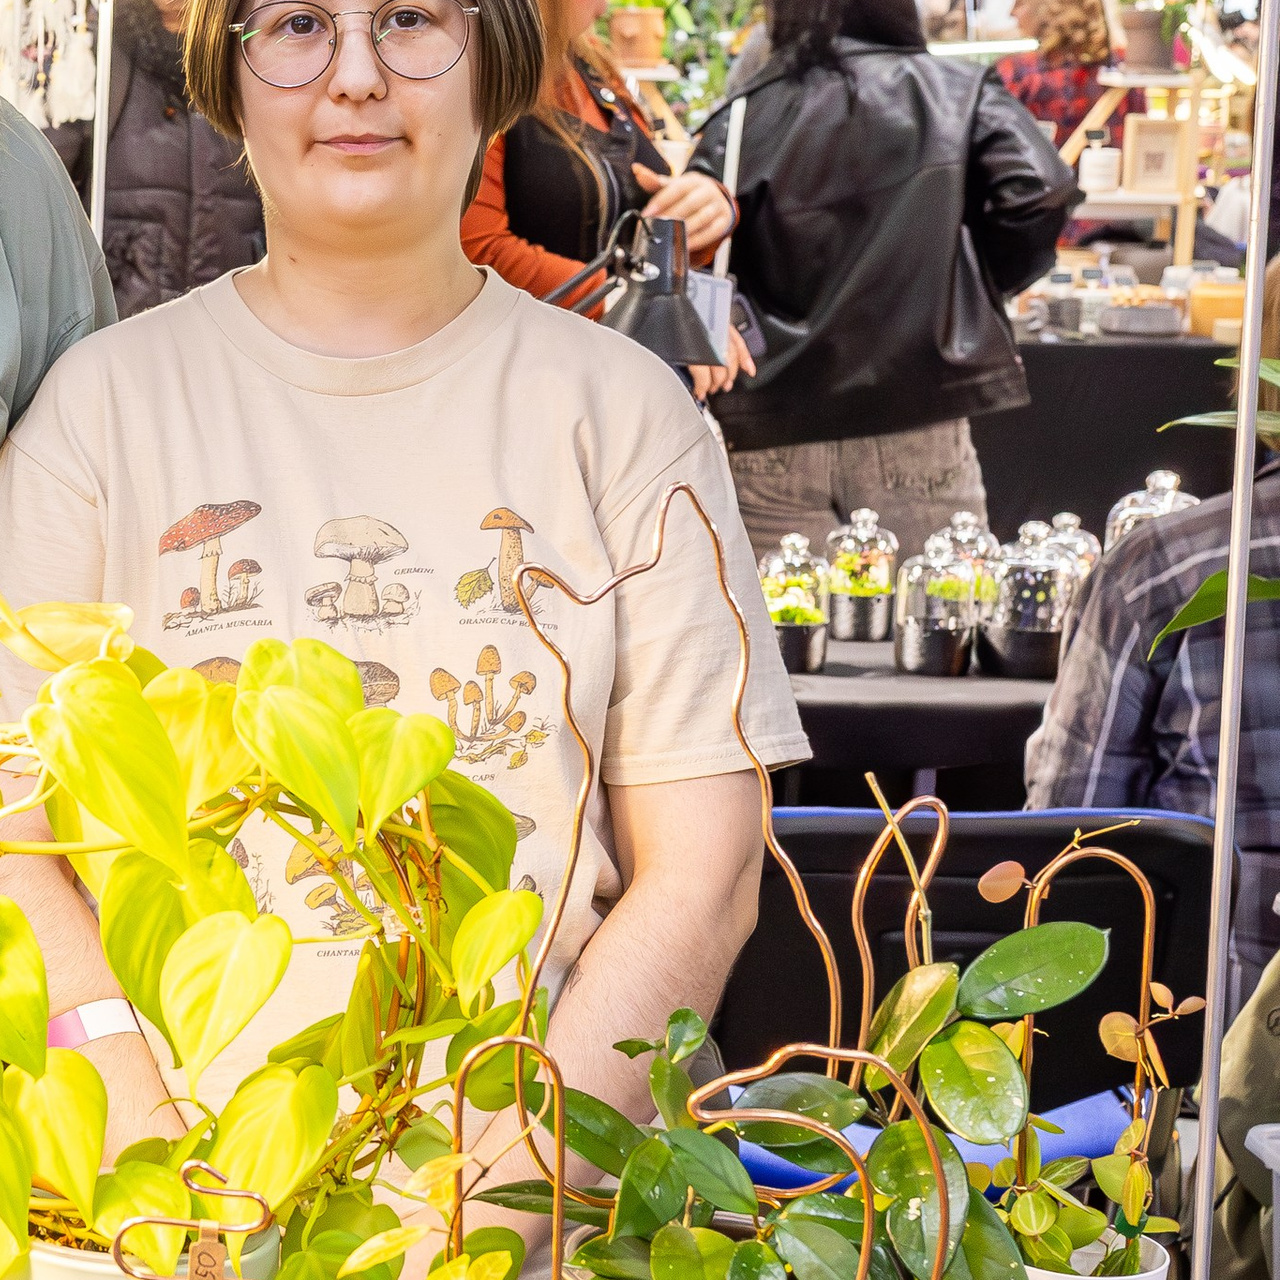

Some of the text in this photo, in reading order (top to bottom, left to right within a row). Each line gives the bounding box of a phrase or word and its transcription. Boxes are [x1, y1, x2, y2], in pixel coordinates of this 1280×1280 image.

[185, 619, 273, 638] AMANITA MUSCARIA
[459, 617, 559, 631] ORANGE CAP BOTUS
[472, 773, 496, 782] CAPS
[316, 948, 361, 958] CHANTAR
